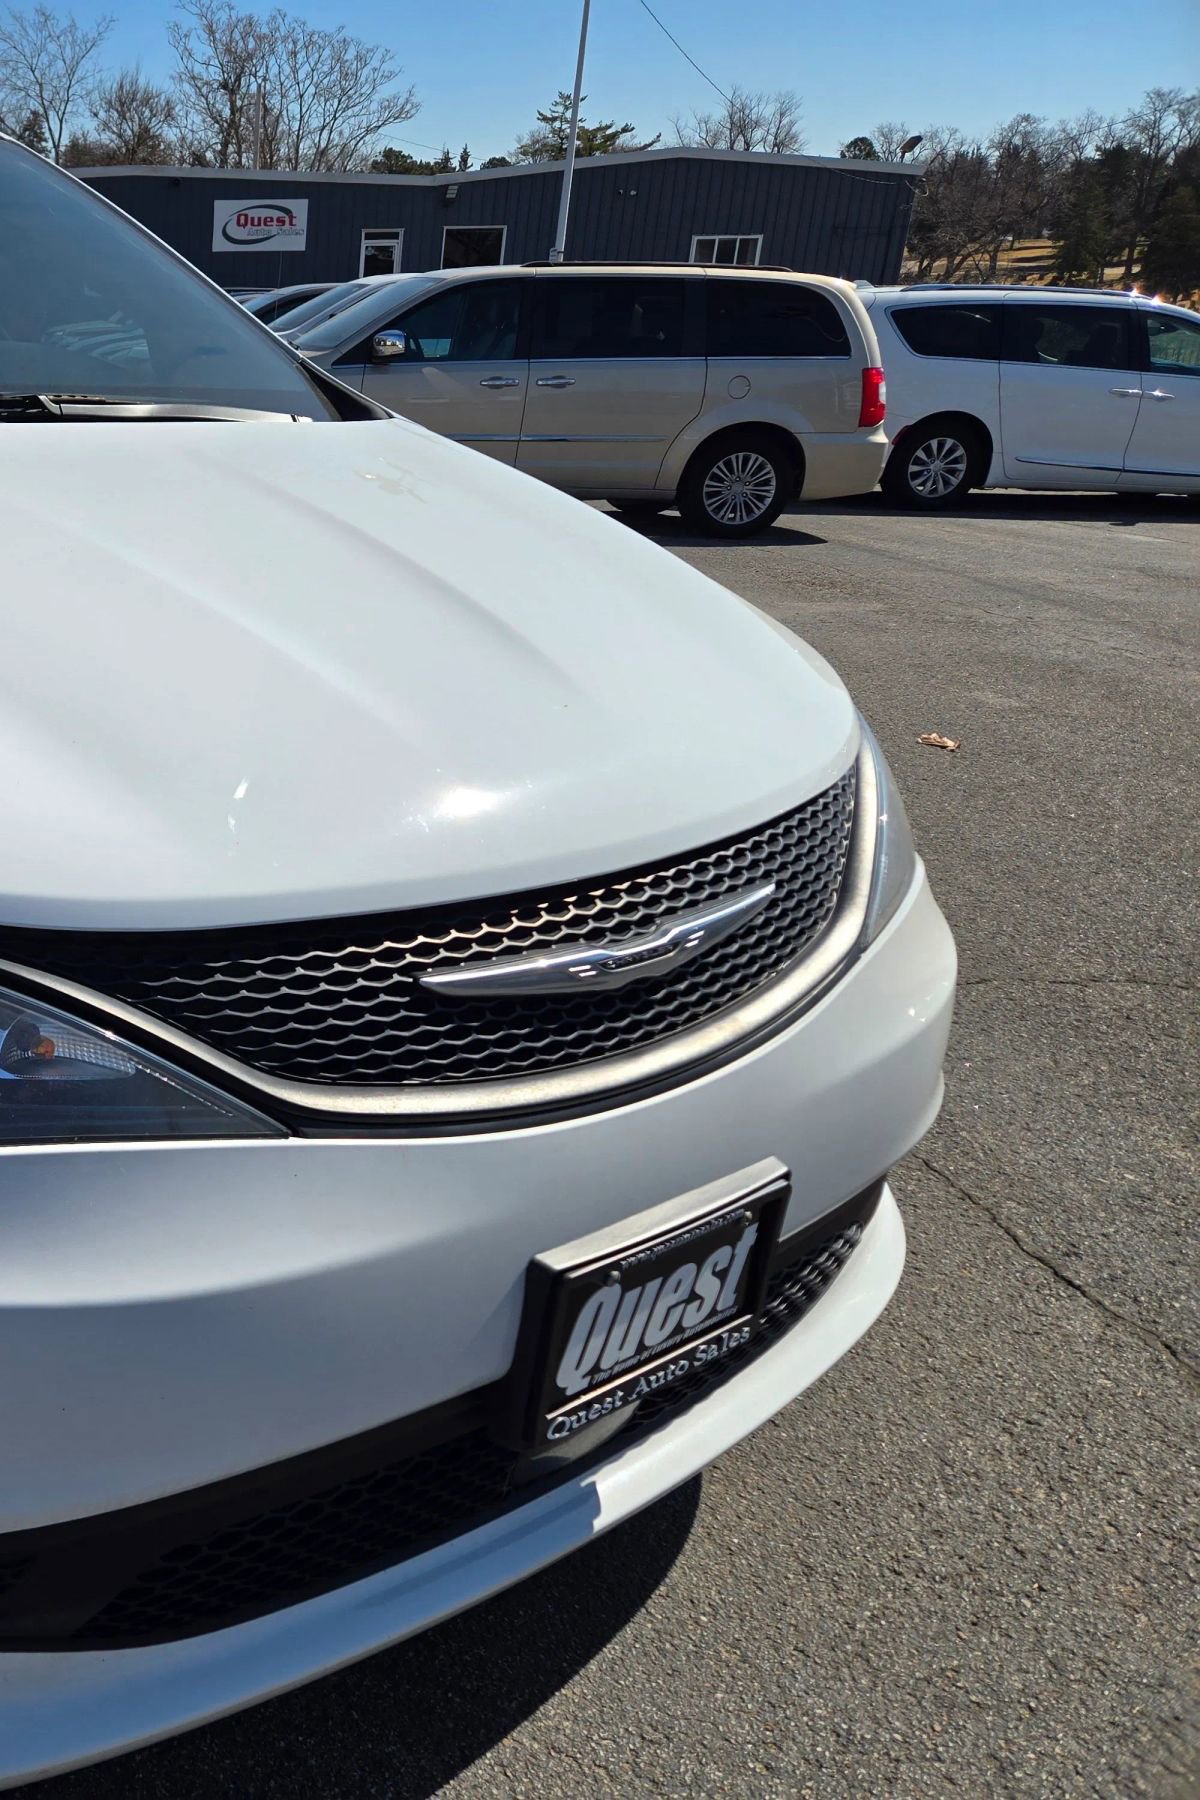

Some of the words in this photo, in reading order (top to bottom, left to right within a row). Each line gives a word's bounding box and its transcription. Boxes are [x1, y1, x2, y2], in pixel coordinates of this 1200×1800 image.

[236, 212, 297, 229] Quest
[555, 1221, 759, 1397] Quest
[546, 1390, 624, 1440] Quest
[627, 1359, 690, 1400] Auto
[693, 1326, 751, 1367] Sales
